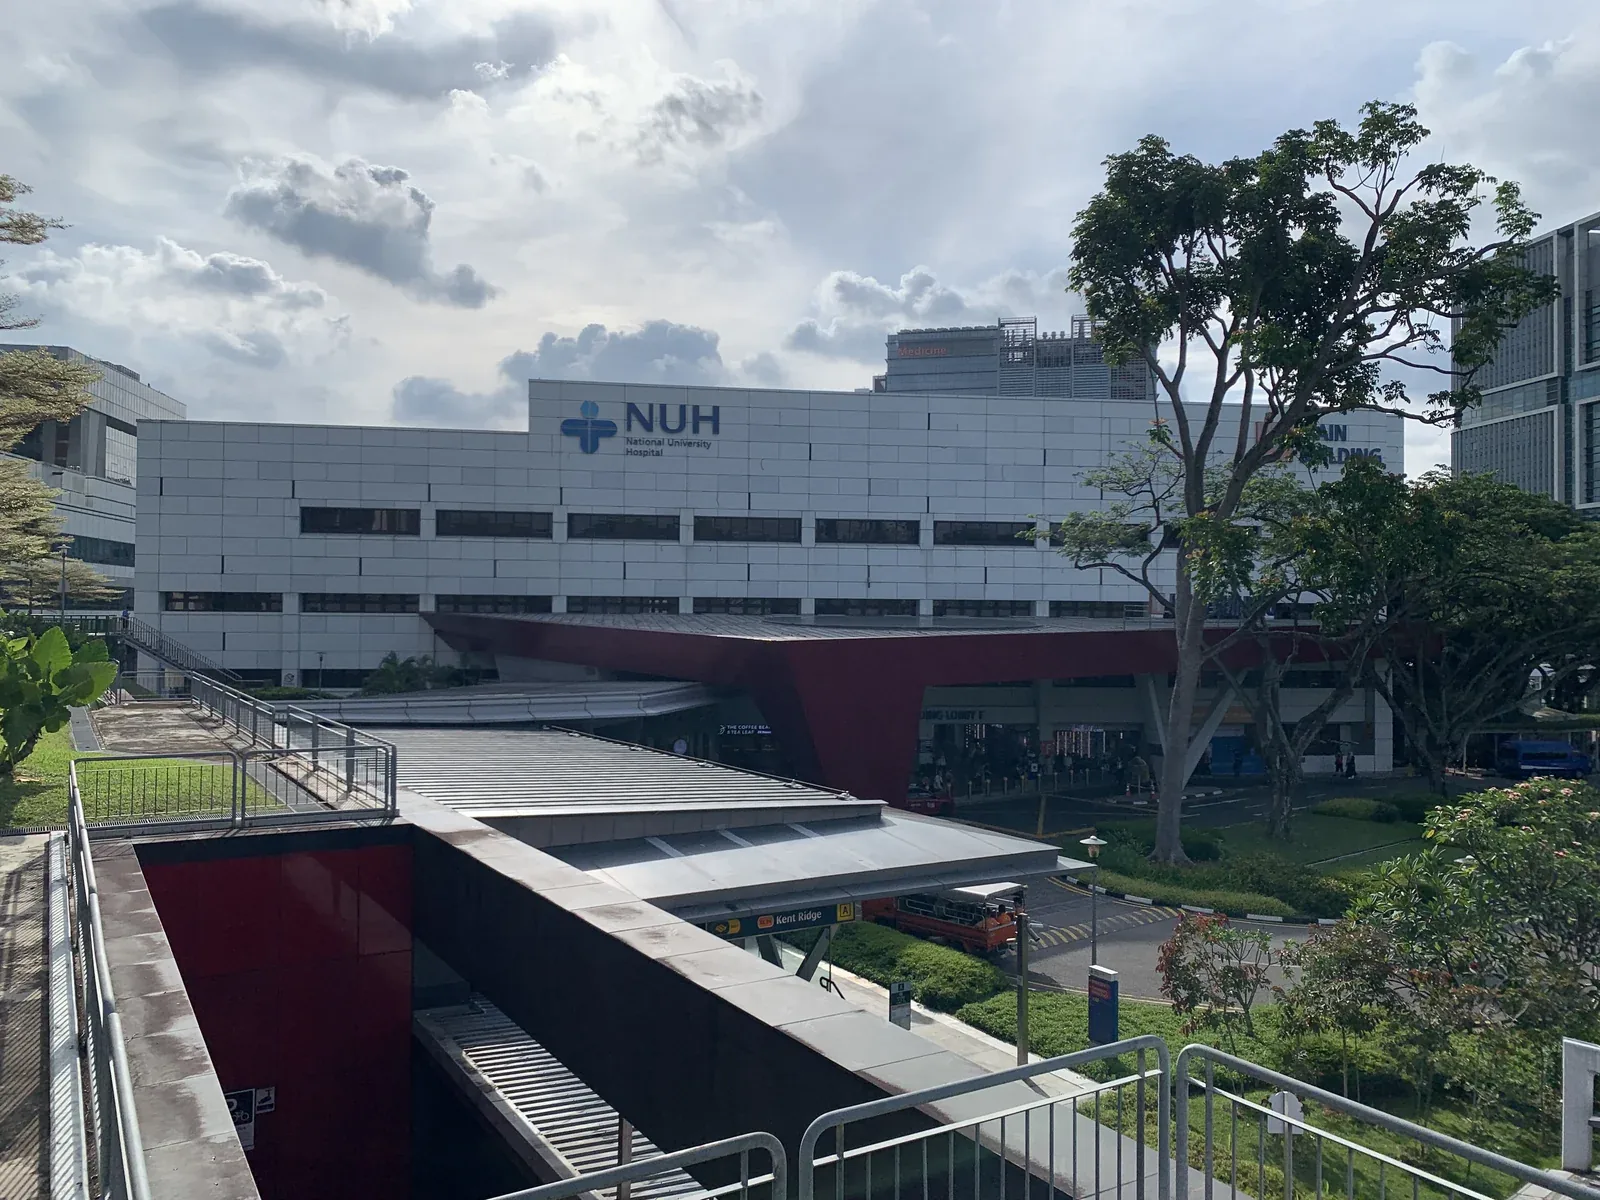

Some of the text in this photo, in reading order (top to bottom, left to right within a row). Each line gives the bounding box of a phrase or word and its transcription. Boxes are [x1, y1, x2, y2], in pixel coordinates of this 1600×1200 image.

[897, 346, 947, 357] Medicine
[626, 402, 720, 435] NUH
[1317, 424, 1347, 442] AIN
[626, 437, 712, 450] National University
[626, 448, 663, 457] Hospital
[1303, 447, 1382, 464] LDING
[776, 914, 796, 925] Kent
[798, 911, 822, 922] Ridge
